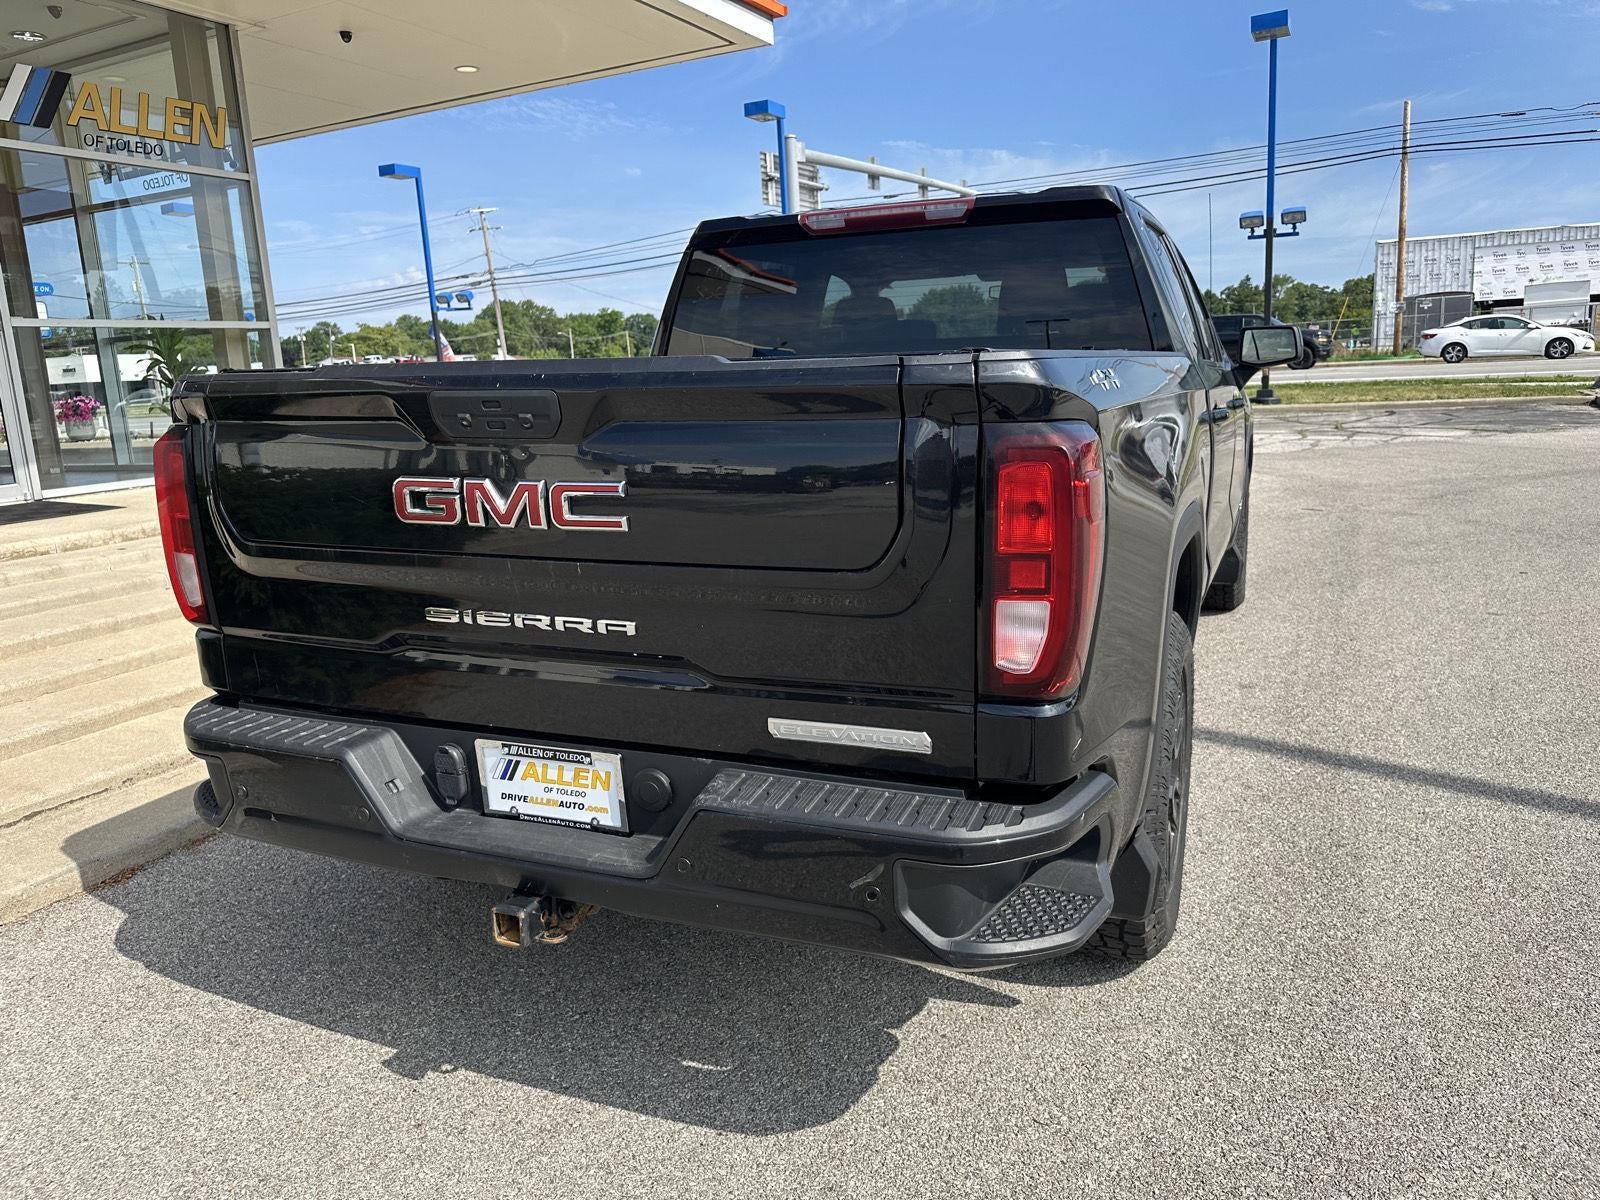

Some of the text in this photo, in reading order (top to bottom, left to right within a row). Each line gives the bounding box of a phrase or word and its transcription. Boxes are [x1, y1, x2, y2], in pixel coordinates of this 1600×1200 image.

[67, 81, 226, 149] ALLEN
[83, 133, 104, 147] OF
[107, 137, 164, 156] TOLEDO
[392, 476, 629, 532] GMC
[425, 606, 637, 636] SIERRA
[779, 724, 917, 747] ELEVATION
[517, 746, 585, 761] ALLEN OF TOLEDO
[520, 762, 611, 791] ALLEN
[501, 792, 609, 814] DRIVEALLENAUTO.com
[543, 786, 587, 798] OF TOLEDO
